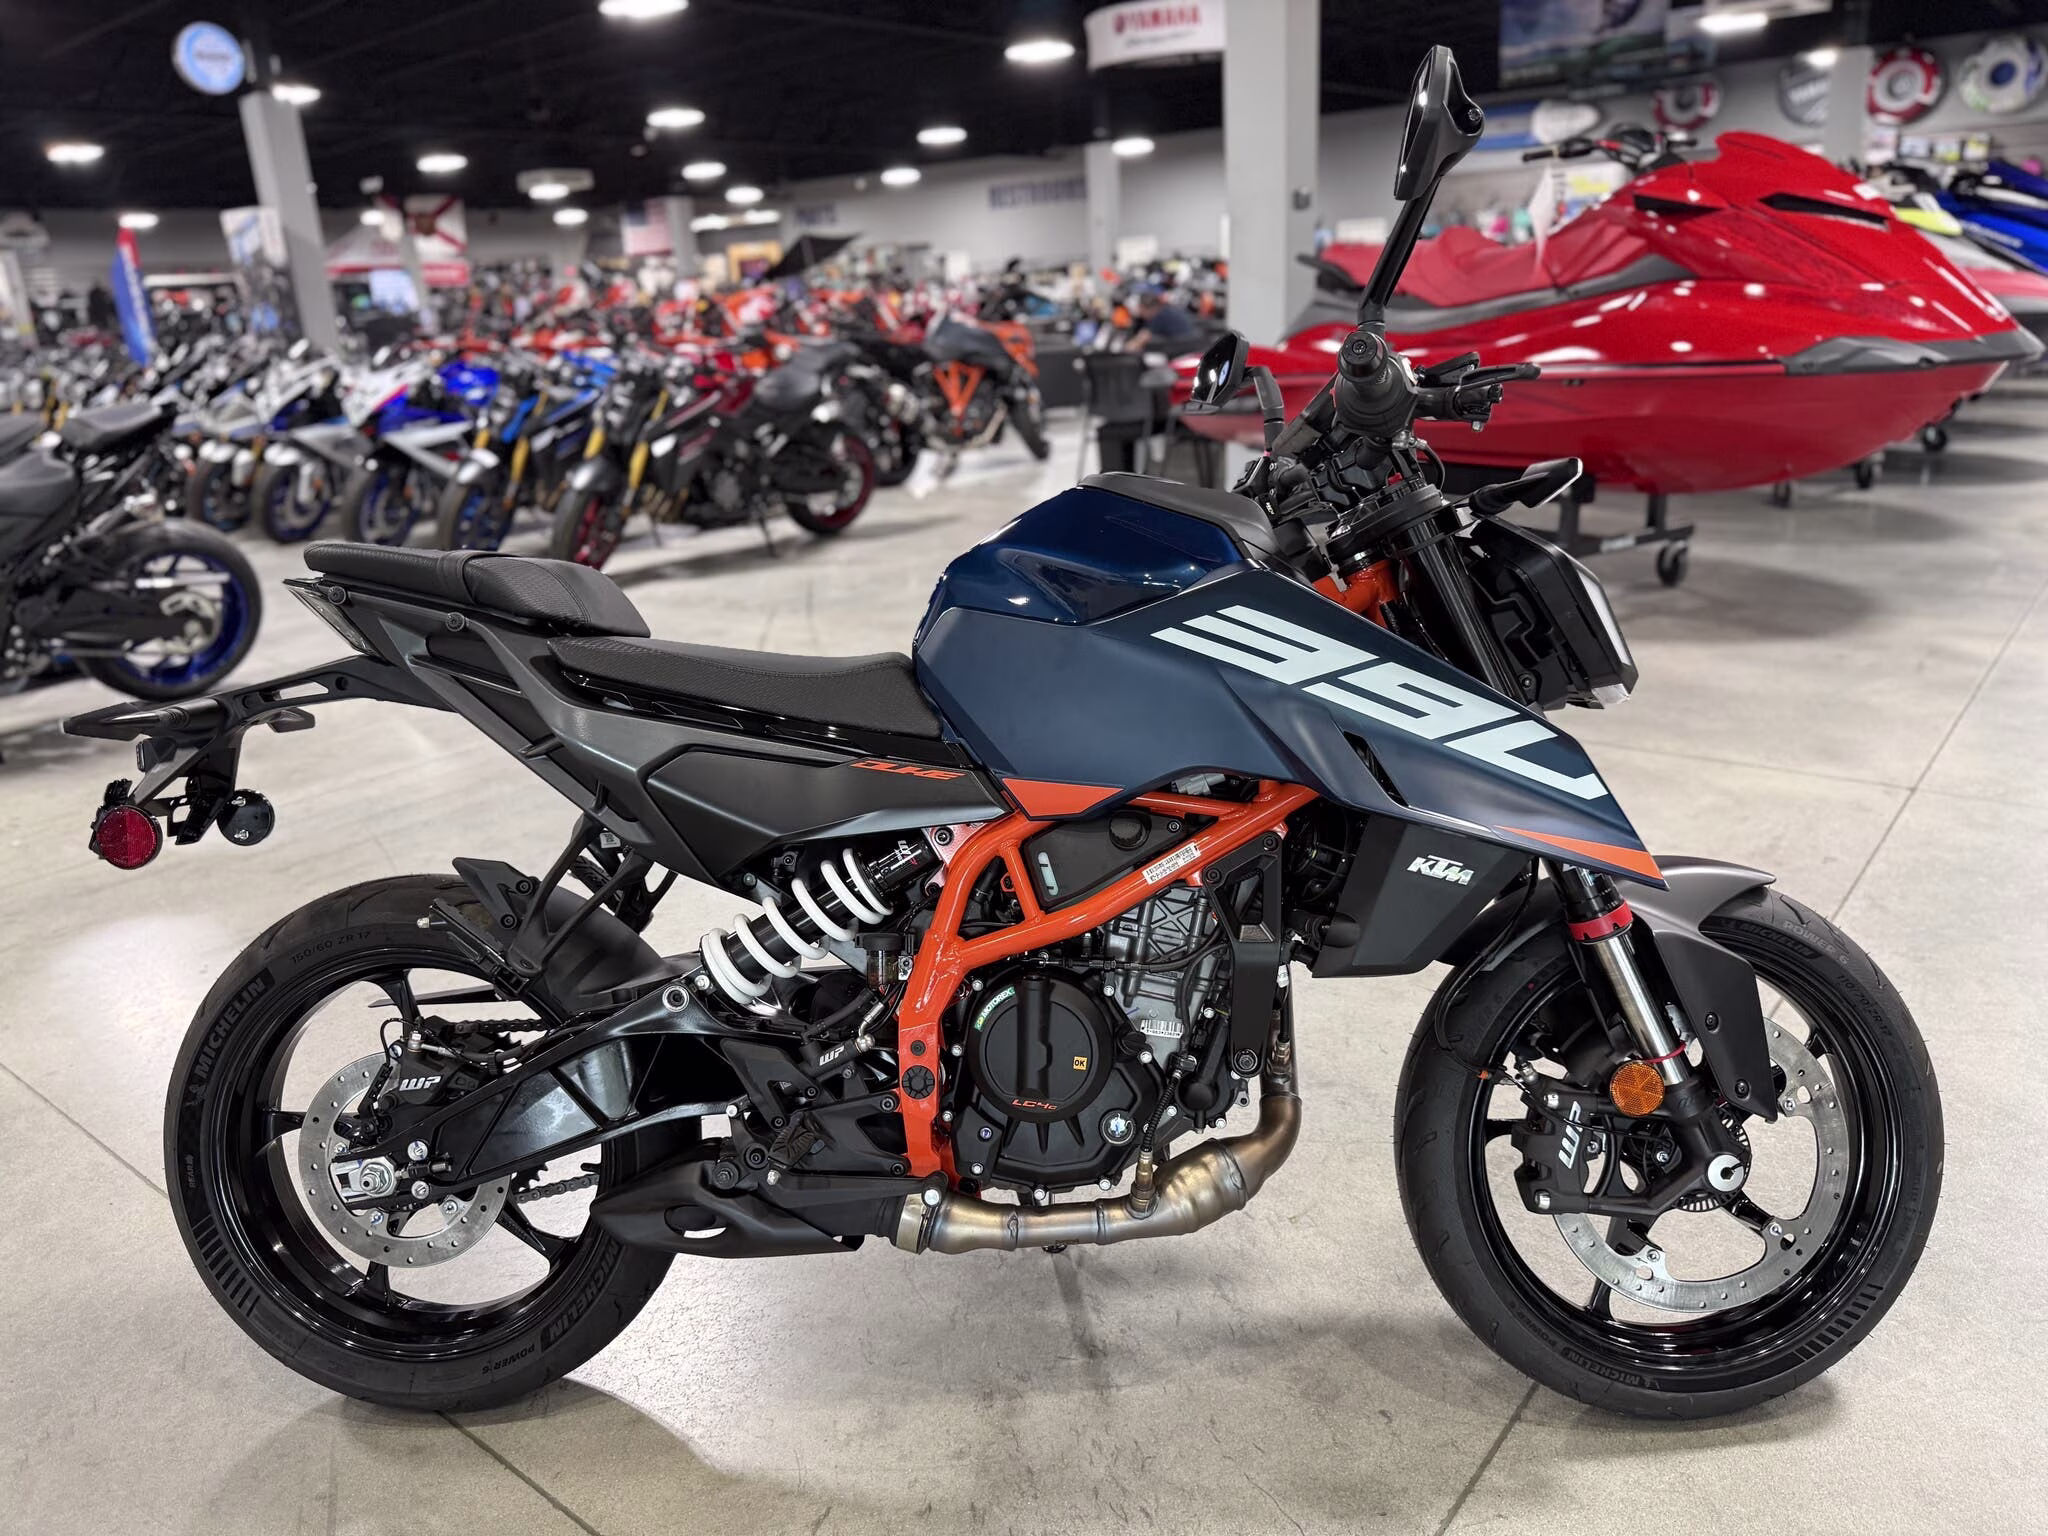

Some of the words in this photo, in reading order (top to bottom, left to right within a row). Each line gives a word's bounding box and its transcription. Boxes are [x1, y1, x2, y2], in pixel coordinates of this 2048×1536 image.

[850, 760, 966, 780] DUKE
[1407, 854, 1475, 886] KTM
[1783, 920, 1838, 954] POWER
[1839, 954, 1849, 965] 6
[980, 987, 1013, 1019] MOTOREX
[195, 977, 266, 1080] MICHELIN
[819, 1045, 845, 1067] WP
[399, 1076, 441, 1091] WP
[1558, 1101, 1584, 1170] WP
[548, 1236, 622, 1342] MICHELIN
[493, 1343, 535, 1370] POWER
[1566, 1350, 1641, 1385] MICHELIN
